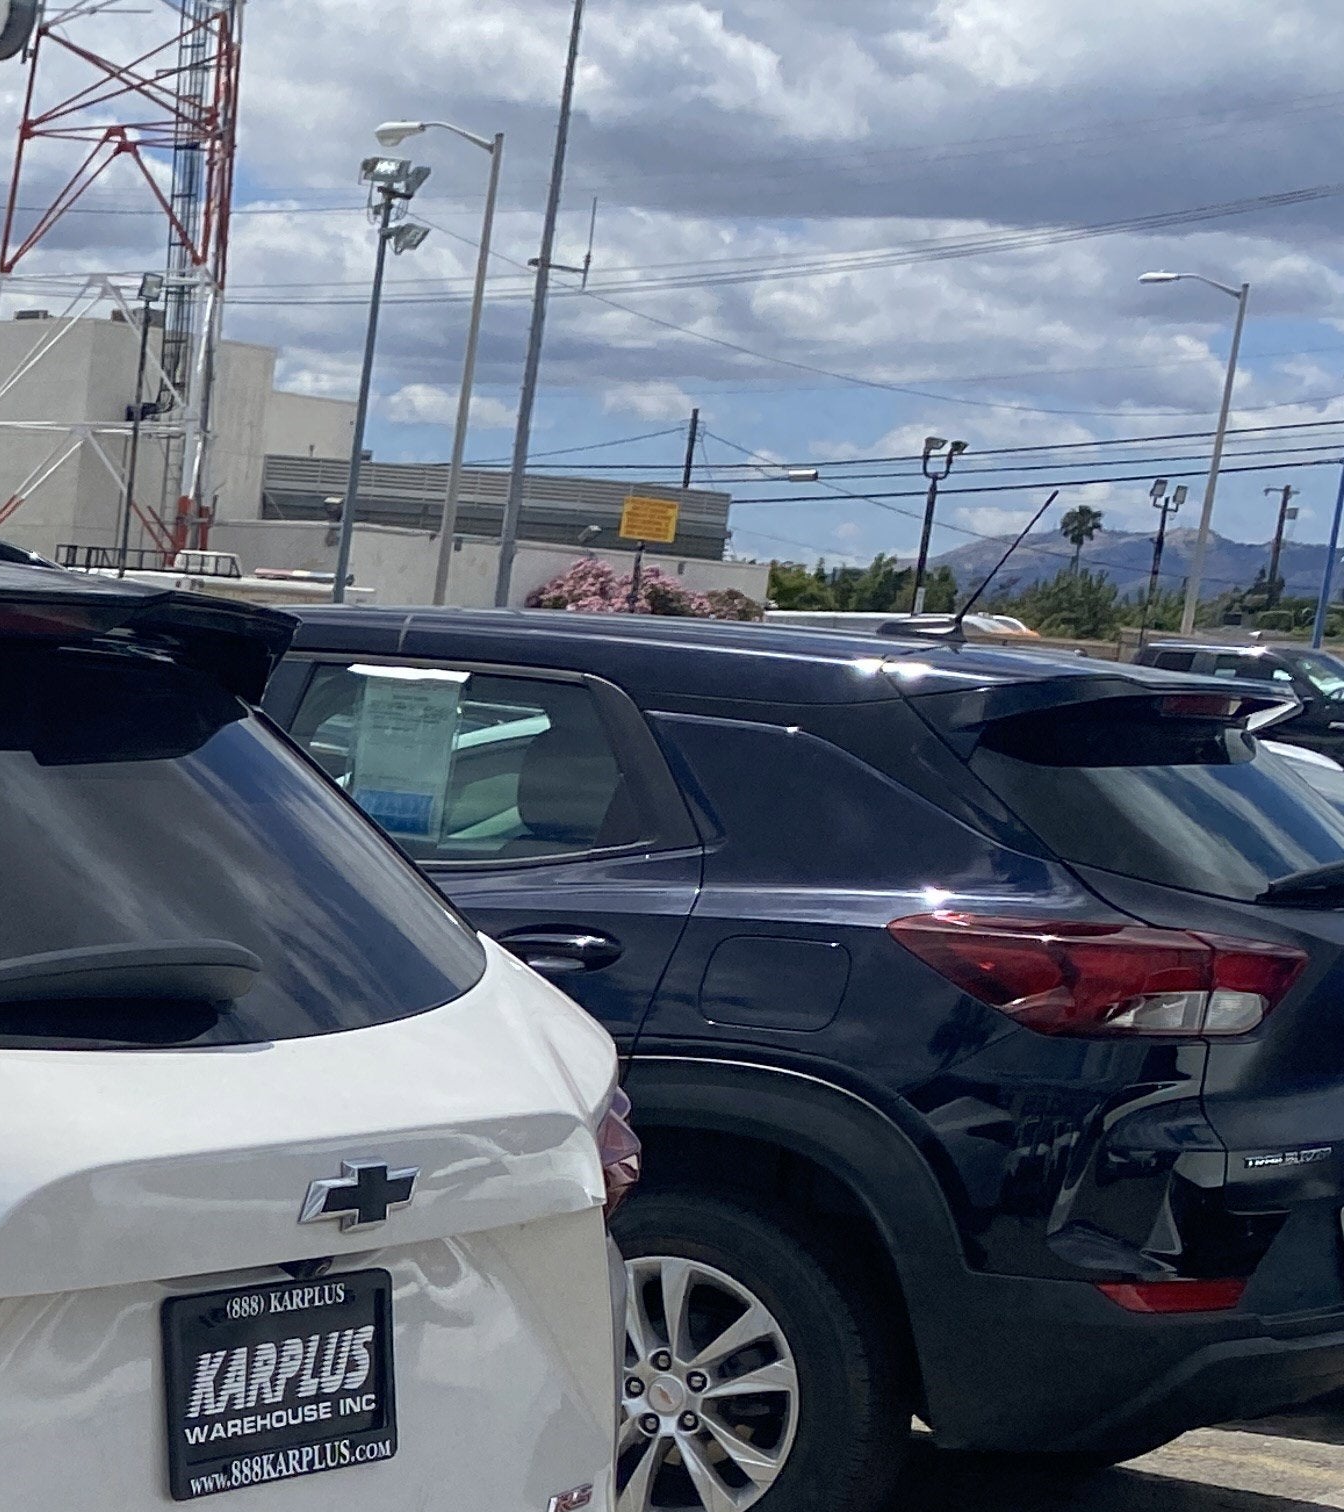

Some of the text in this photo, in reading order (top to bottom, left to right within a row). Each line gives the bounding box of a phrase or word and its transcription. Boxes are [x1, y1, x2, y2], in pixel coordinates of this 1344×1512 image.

[226, 1283, 345, 1319] (888) KARPLUS
[184, 1325, 375, 1418] KARPLUS
[184, 1394, 377, 1445] WAREHOUSE INC
